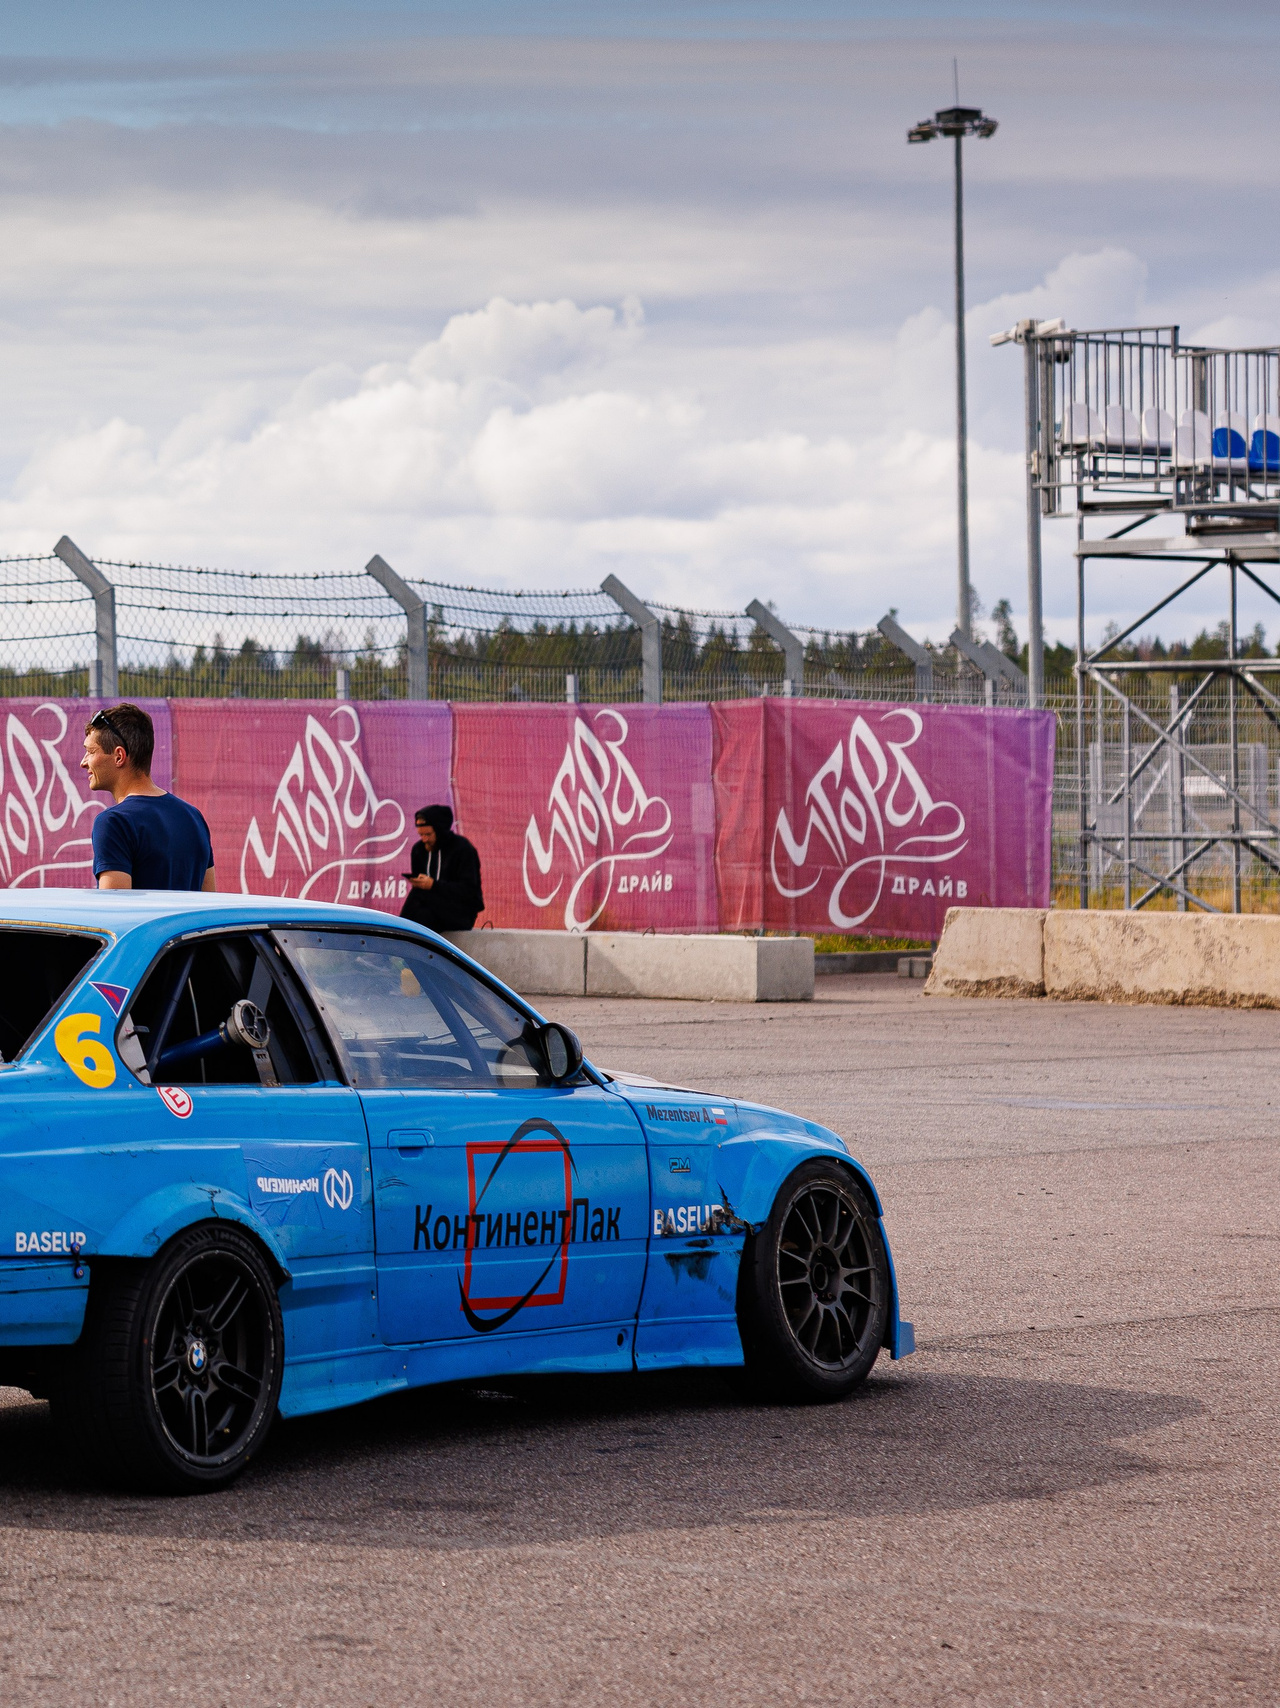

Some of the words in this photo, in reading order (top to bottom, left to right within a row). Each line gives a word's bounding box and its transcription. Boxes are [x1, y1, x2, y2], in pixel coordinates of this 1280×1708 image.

[347, 876, 407, 899] ДРАЙВ
[618, 870, 673, 893] ДРАЙВ
[891, 876, 968, 898] ДРАЙВ
[54, 1013, 116, 1089] 6
[646, 1105, 700, 1122] Mezentsev
[702, 1108, 714, 1124] A.
[414, 1198, 621, 1250] КонтинентПак
[16, 1232, 86, 1252] BASEUP
